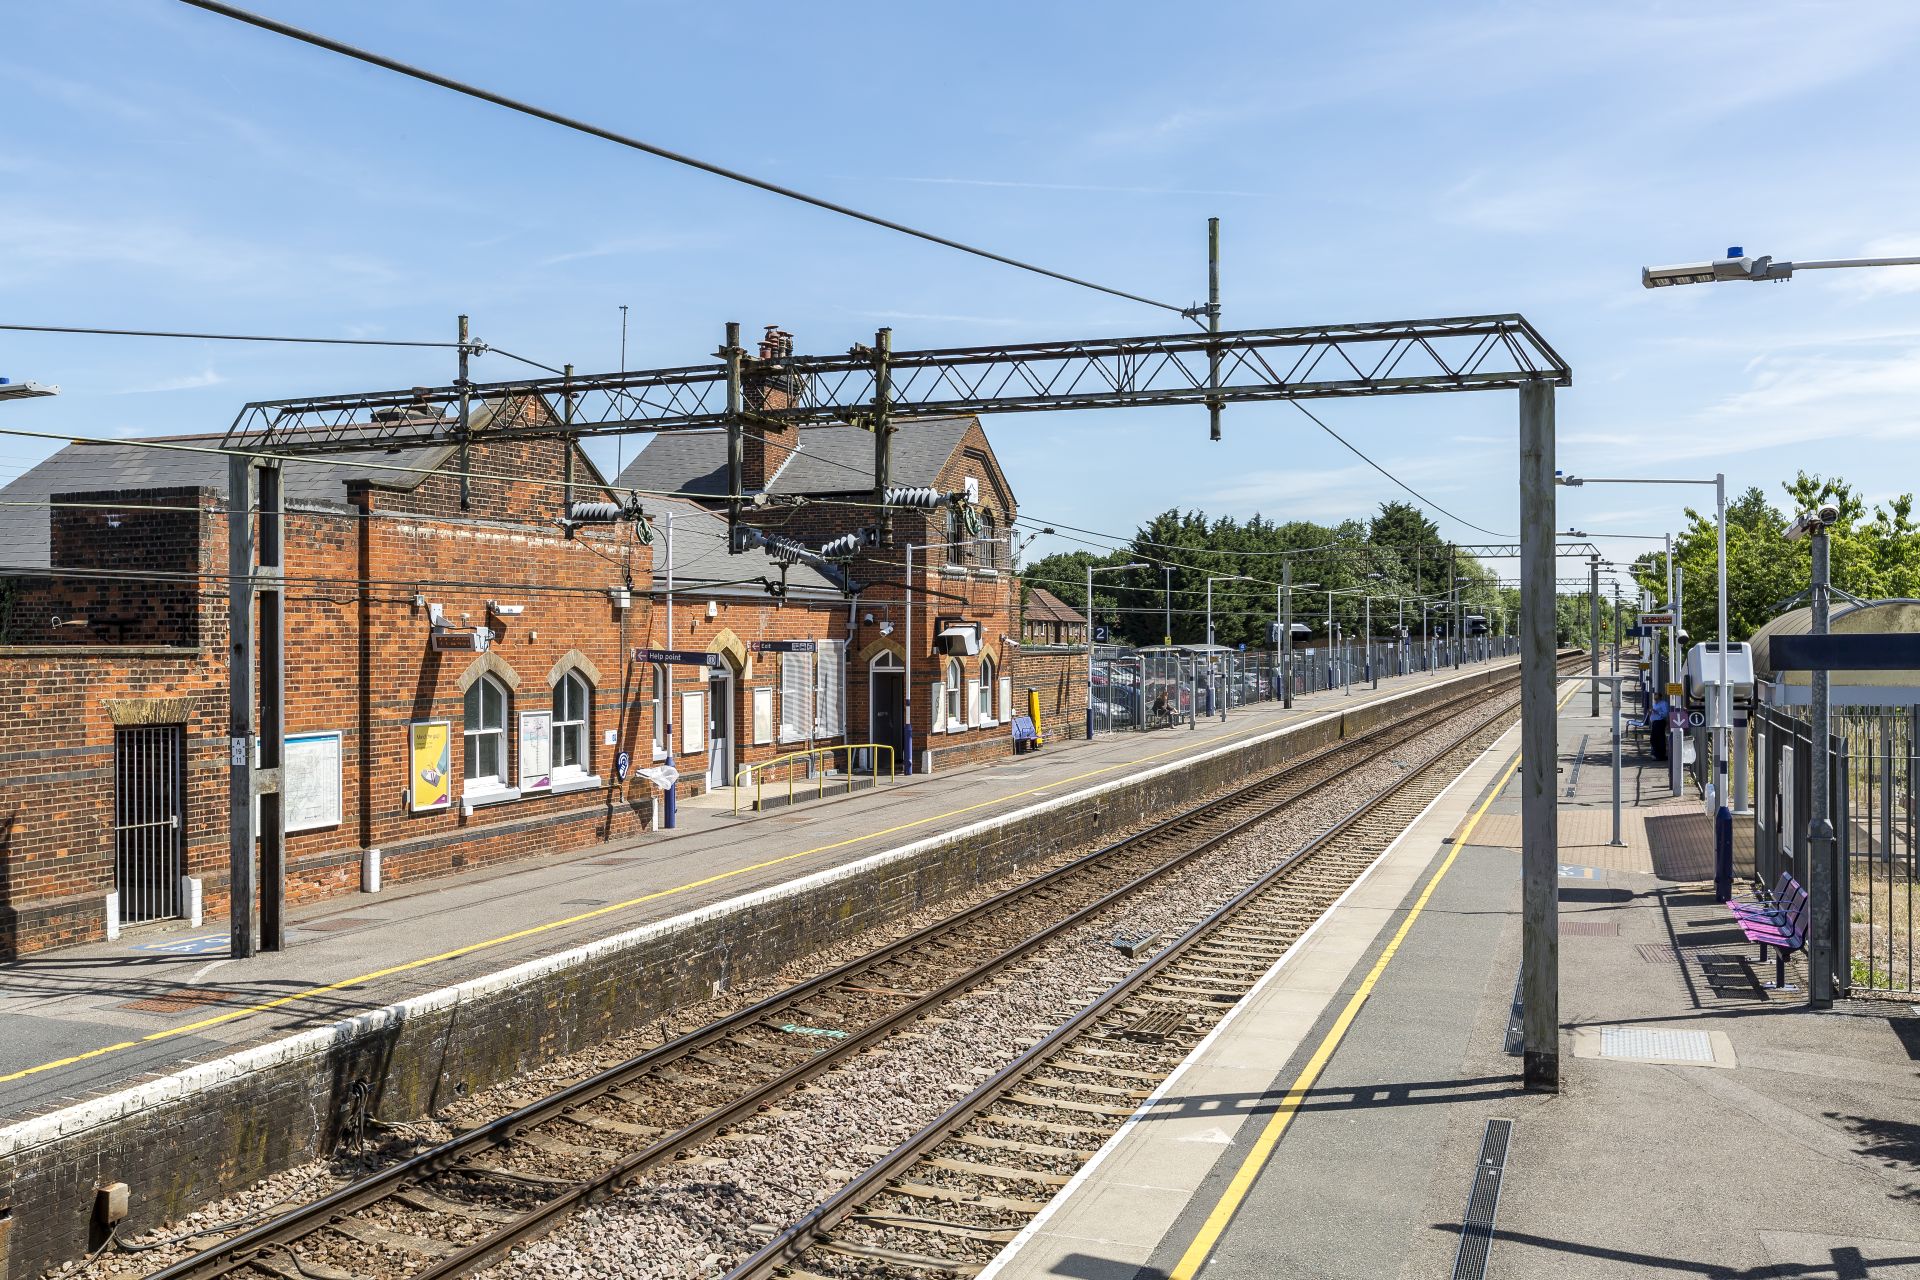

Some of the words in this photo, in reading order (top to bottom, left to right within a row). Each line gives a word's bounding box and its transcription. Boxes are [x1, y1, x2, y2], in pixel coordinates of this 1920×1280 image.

[1096, 627, 1105, 639] 2
[649, 652, 664, 660] Help
[664, 653, 682, 662] point
